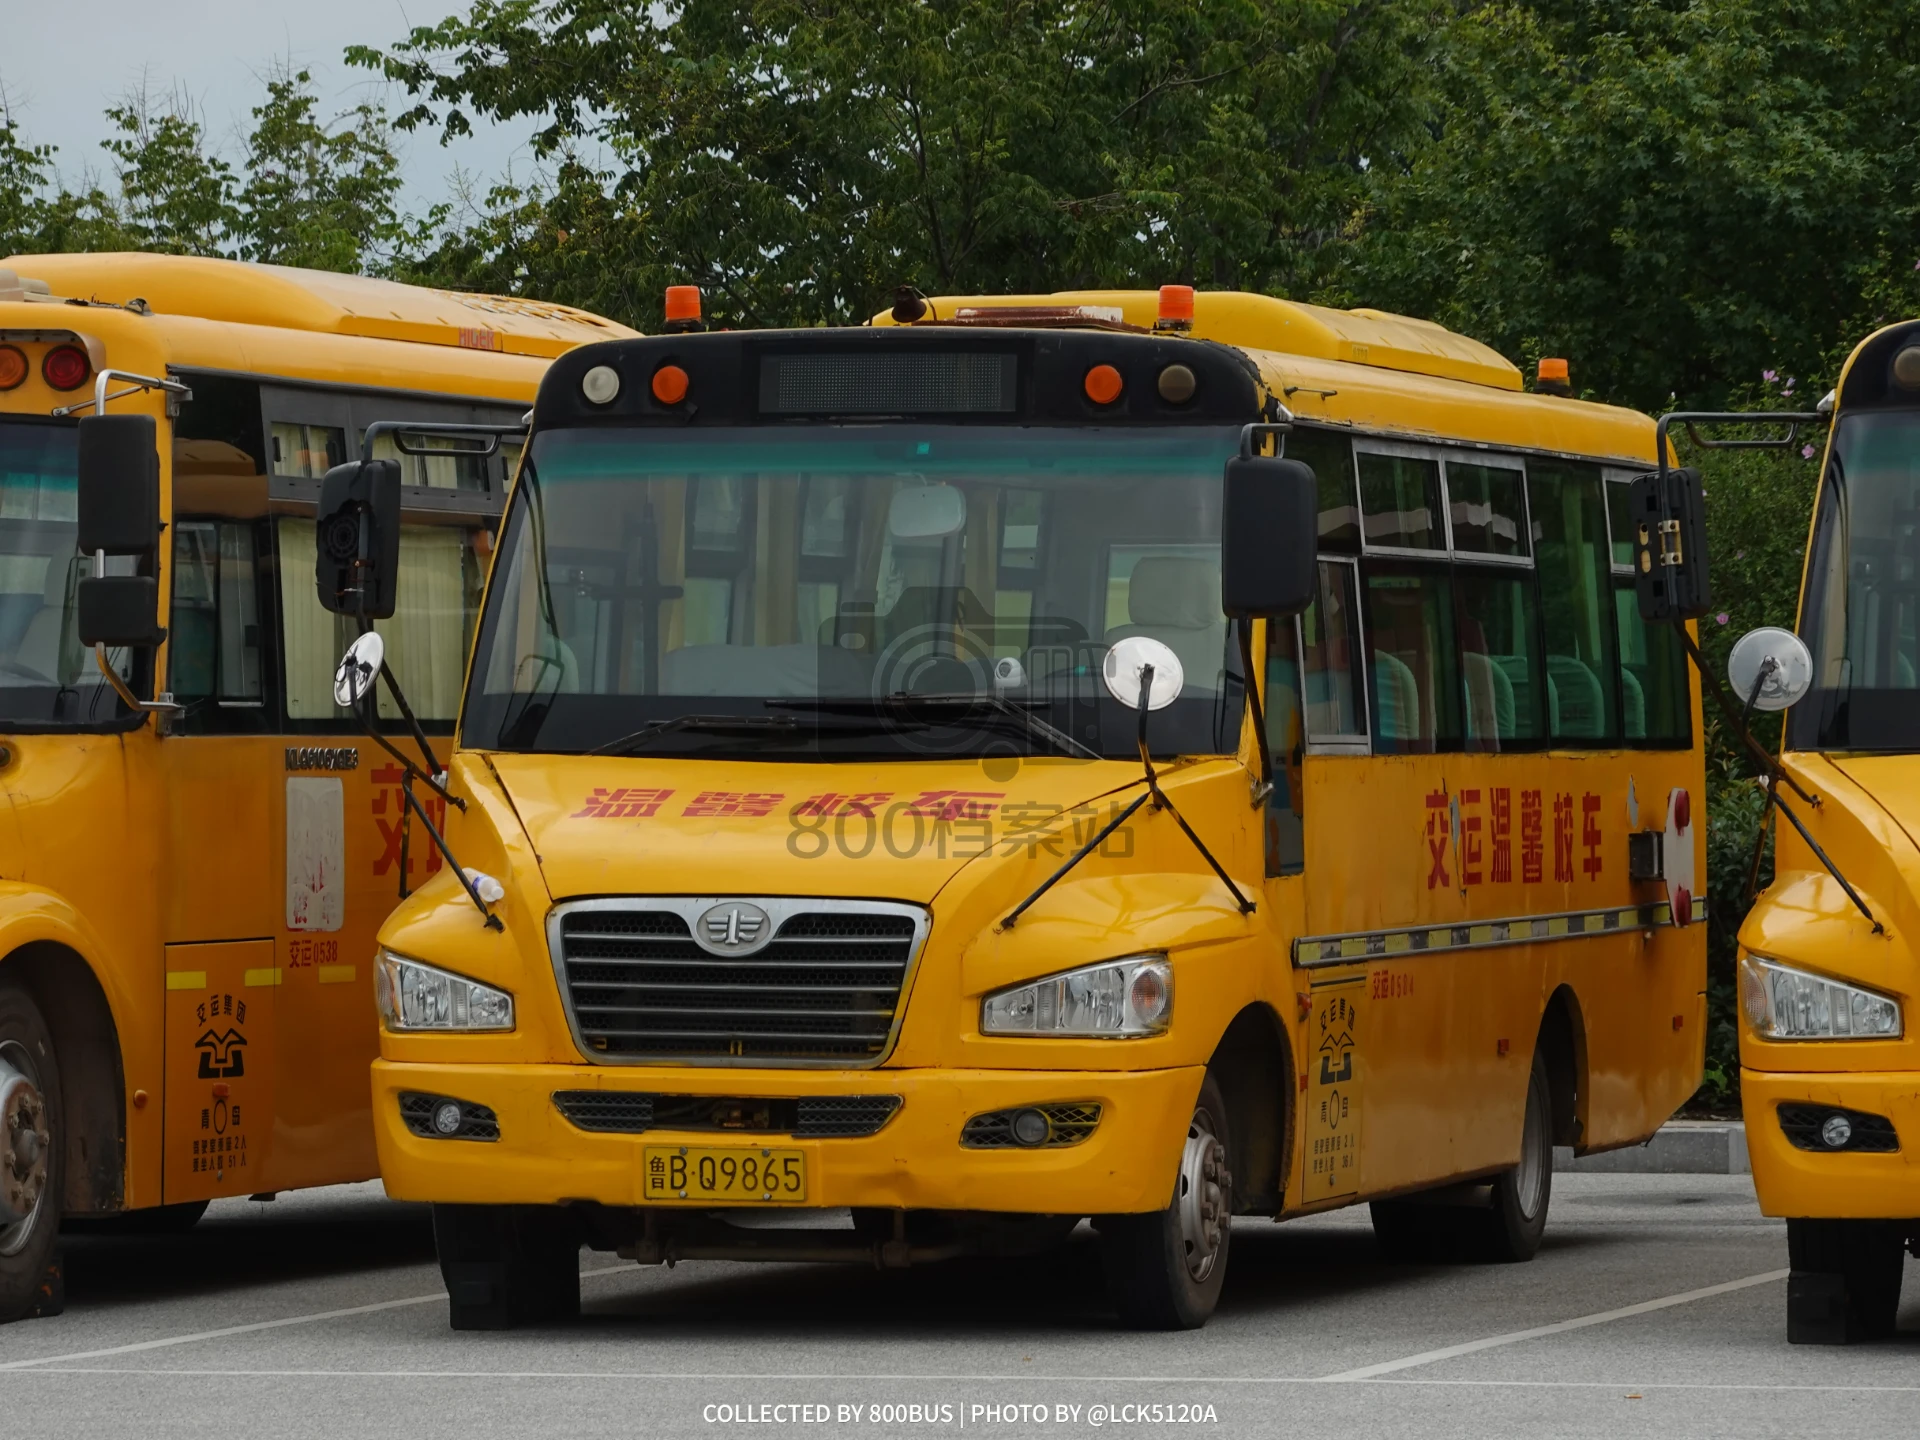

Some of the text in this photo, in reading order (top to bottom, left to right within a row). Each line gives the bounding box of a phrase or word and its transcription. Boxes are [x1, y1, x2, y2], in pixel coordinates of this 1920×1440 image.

[458, 327, 496, 349] HIGER
[569, 787, 1005, 822] 温馨校车
[1425, 787, 1603, 890] 交运温馨校车
[289, 939, 338, 968] 交运0538
[196, 993, 247, 1027] 交运集团
